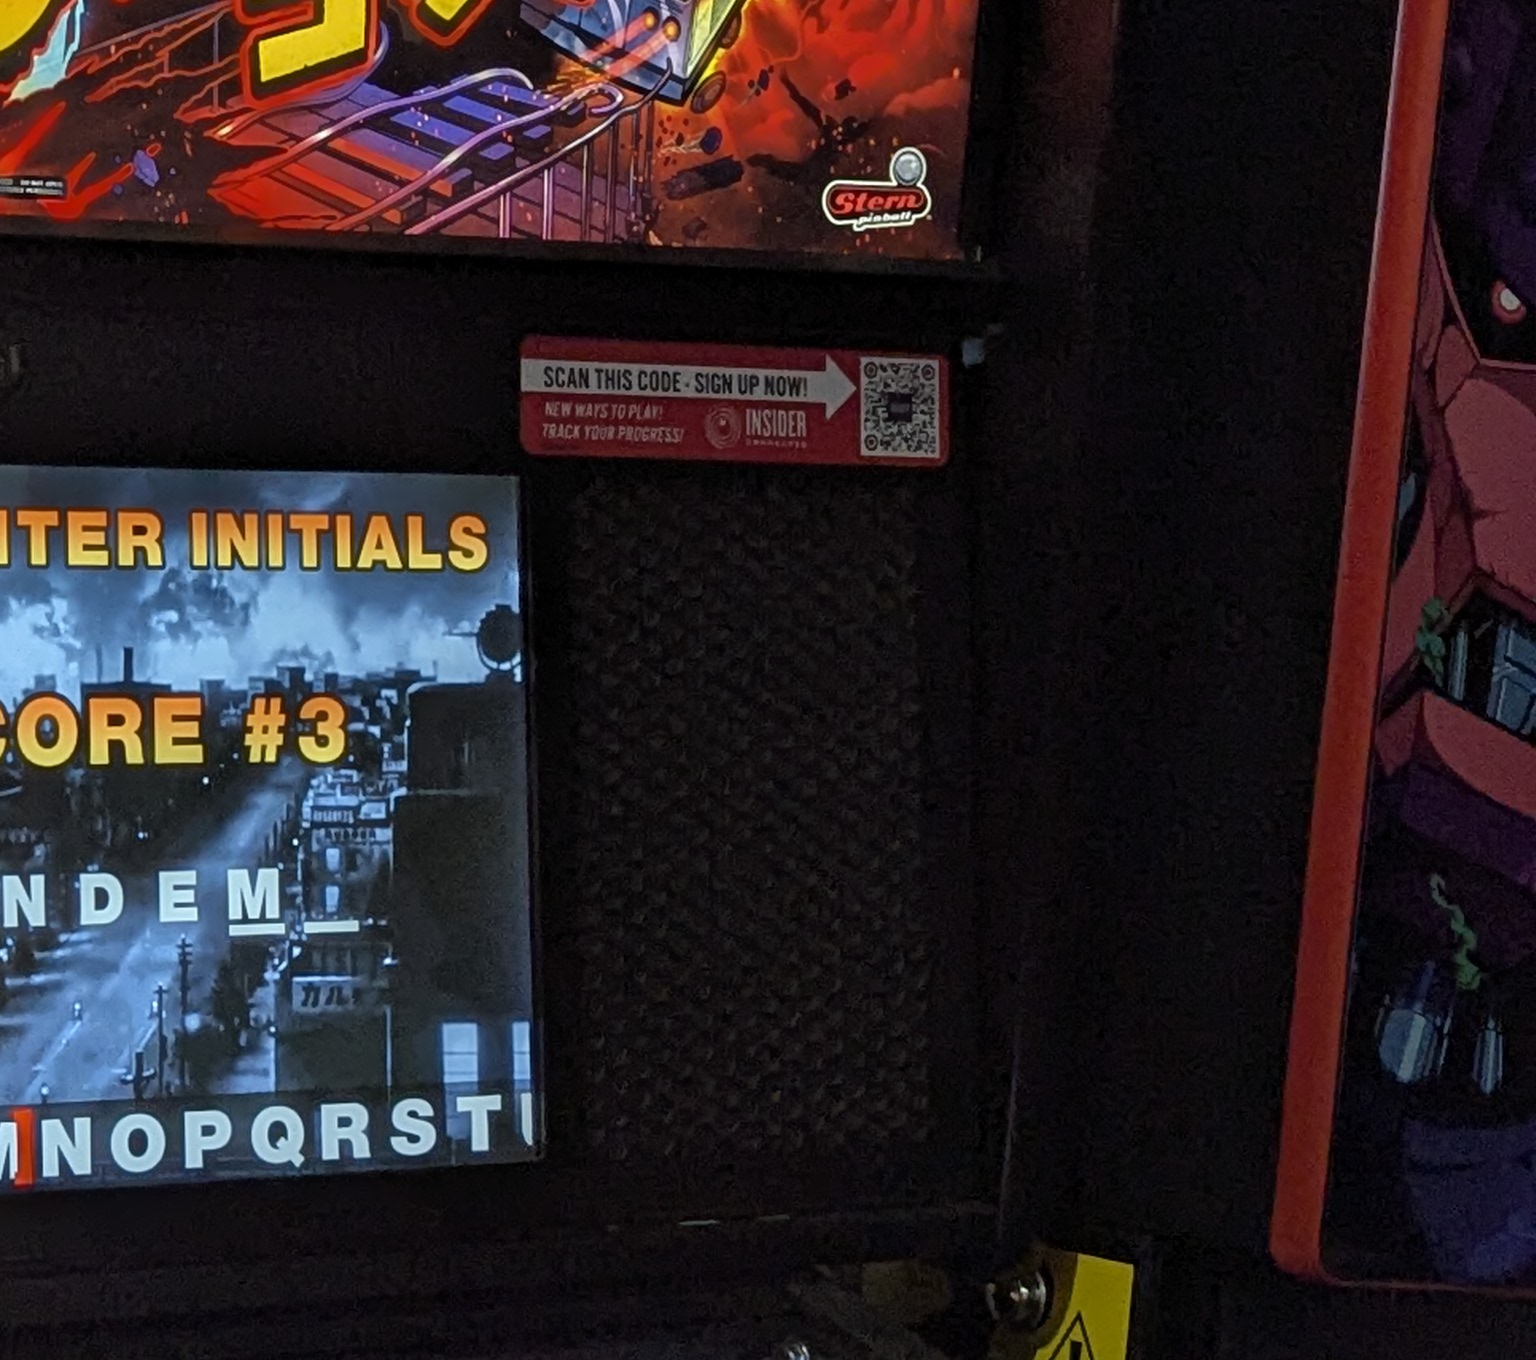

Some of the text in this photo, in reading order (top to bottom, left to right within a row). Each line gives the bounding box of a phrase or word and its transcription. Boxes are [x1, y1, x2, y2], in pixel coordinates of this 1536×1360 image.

[835, 192, 918, 214] Stern
[857, 210, 913, 226] pinball
[543, 366, 590, 389] SCAN
[595, 368, 633, 391] THIS
[638, 370, 681, 393] CODE
[694, 372, 734, 395] SIGN
[737, 374, 760, 396] UP
[764, 376, 808, 398] NOW!
[545, 401, 572, 418] NEW
[575, 402, 609, 419] WAYS
[611, 403, 626, 420] TO
[745, 407, 808, 439] INSIDER
[542, 423, 581, 439] TRACK
[584, 424, 616, 441] YOUR
[189, 512, 491, 574] INITIALS
[243, 691, 349, 768] #3
